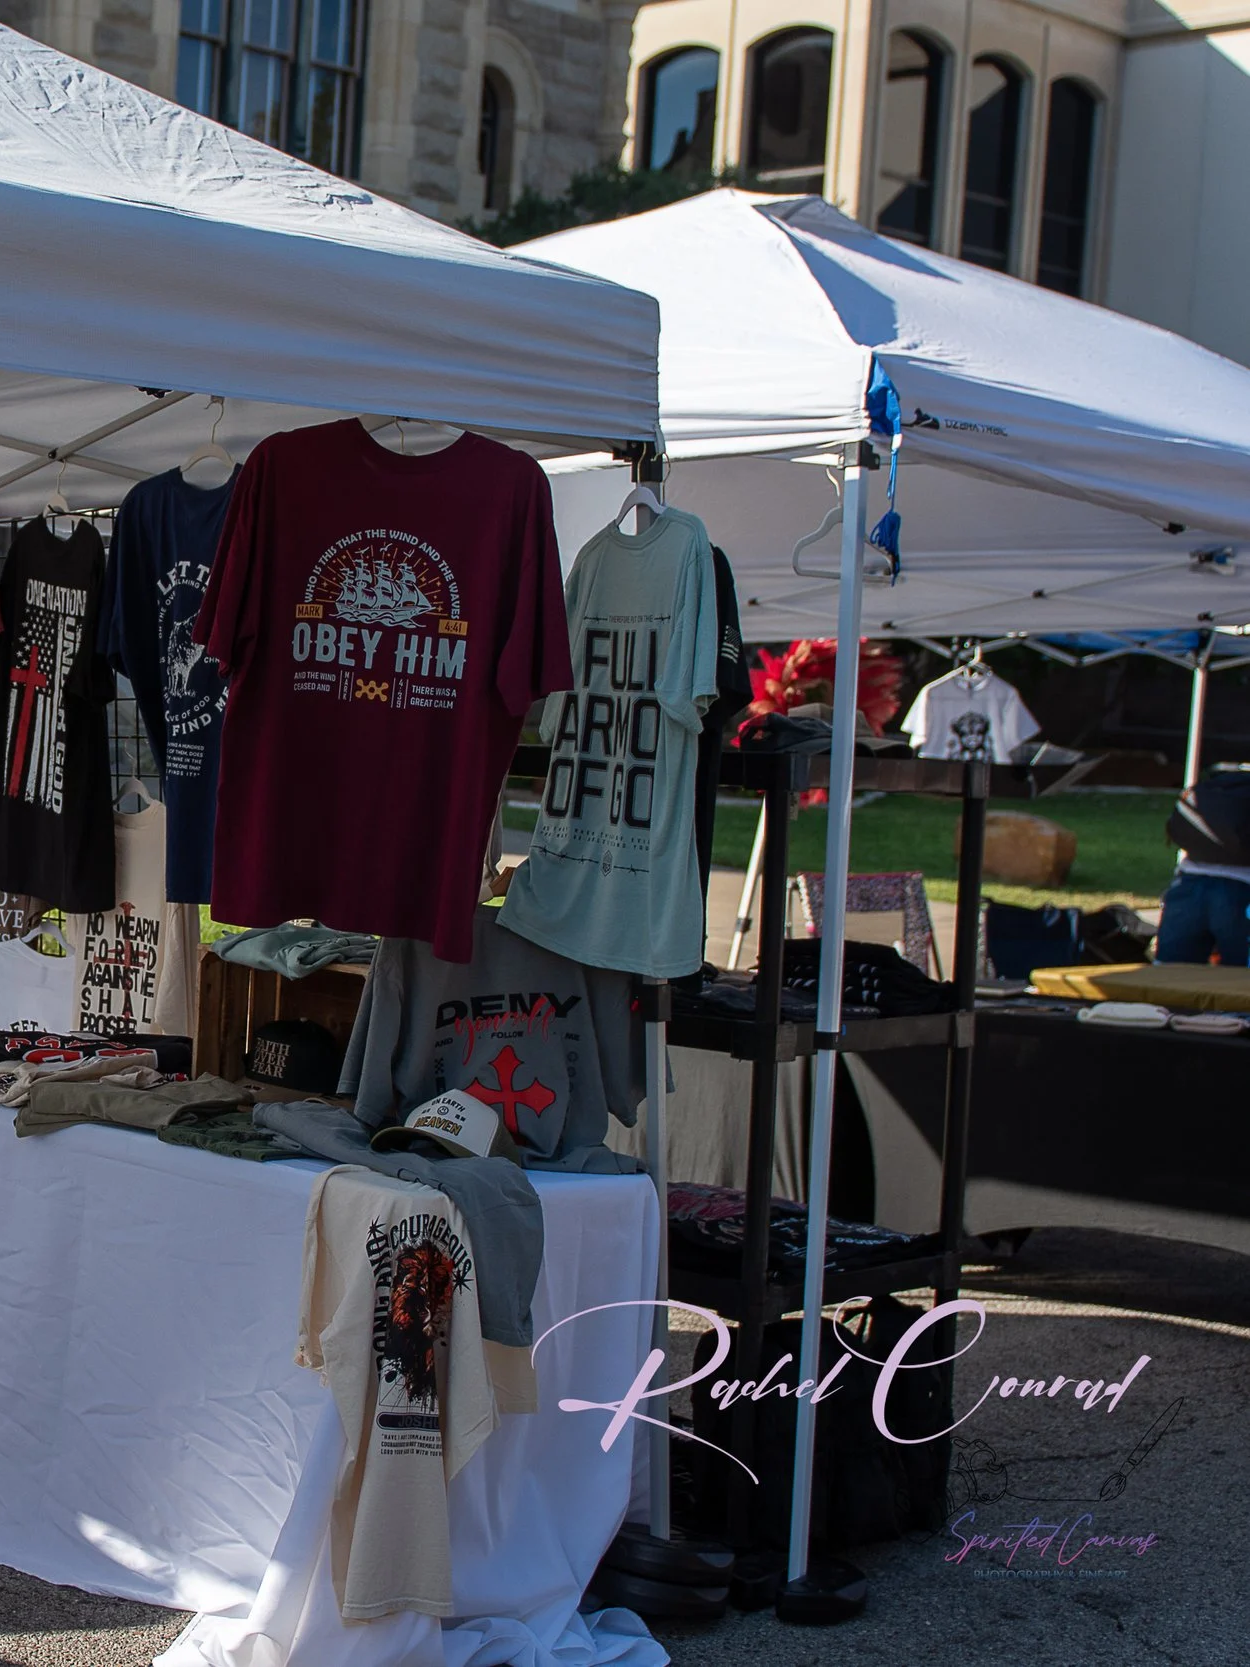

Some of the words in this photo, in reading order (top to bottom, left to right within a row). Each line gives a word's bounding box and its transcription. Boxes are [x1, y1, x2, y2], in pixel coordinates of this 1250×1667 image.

[304, 575, 318, 603] WHO
[312, 565, 322, 575] IS
[318, 545, 337, 566] THIS
[335, 531, 363, 549] THAT
[364, 528, 387, 539] THE
[389, 529, 419, 546] WIND
[418, 542, 441, 562] AND
[437, 560, 455, 582] THE
[448, 582, 461, 620] WAVES
[25, 578, 46, 609] ONE
[46, 579, 87, 617] NATION
[297, 605, 321, 617] MARK
[292, 622, 383, 669] OBEY
[394, 633, 467, 680] HIM
[293, 683, 315, 691] CEASED
[316, 684, 331, 692] AND
[294, 672, 307, 680] AND
[307, 672, 319, 680] THE
[320, 673, 336, 682] WIND
[410, 697, 433, 708] GREAT
[433, 700, 454, 710] CALM
[412, 685, 435, 696] THERE
[435, 687, 451, 697] WAS
[451, 689, 457, 698] A
[181, 709, 191, 719] OF
[193, 695, 210, 712] GOD
[172, 713, 212, 737] FIND
[553, 693, 661, 760] ARMO
[52, 742, 66, 815] GOD
[545, 757, 609, 819] OF
[609, 762, 656, 830] GO
[86, 912, 105, 936] NO
[82, 962, 141, 993] AGAINST
[435, 992, 582, 1029] DENY
[434, 1037, 454, 1048] AND
[490, 1031, 525, 1040] FOLLOW
[564, 1032, 581, 1041] ME
[441, 1097, 466, 1112] EARTH
[413, 1115, 462, 1136] HEAVEN
[389, 1213, 473, 1277] COURAGEOUS
